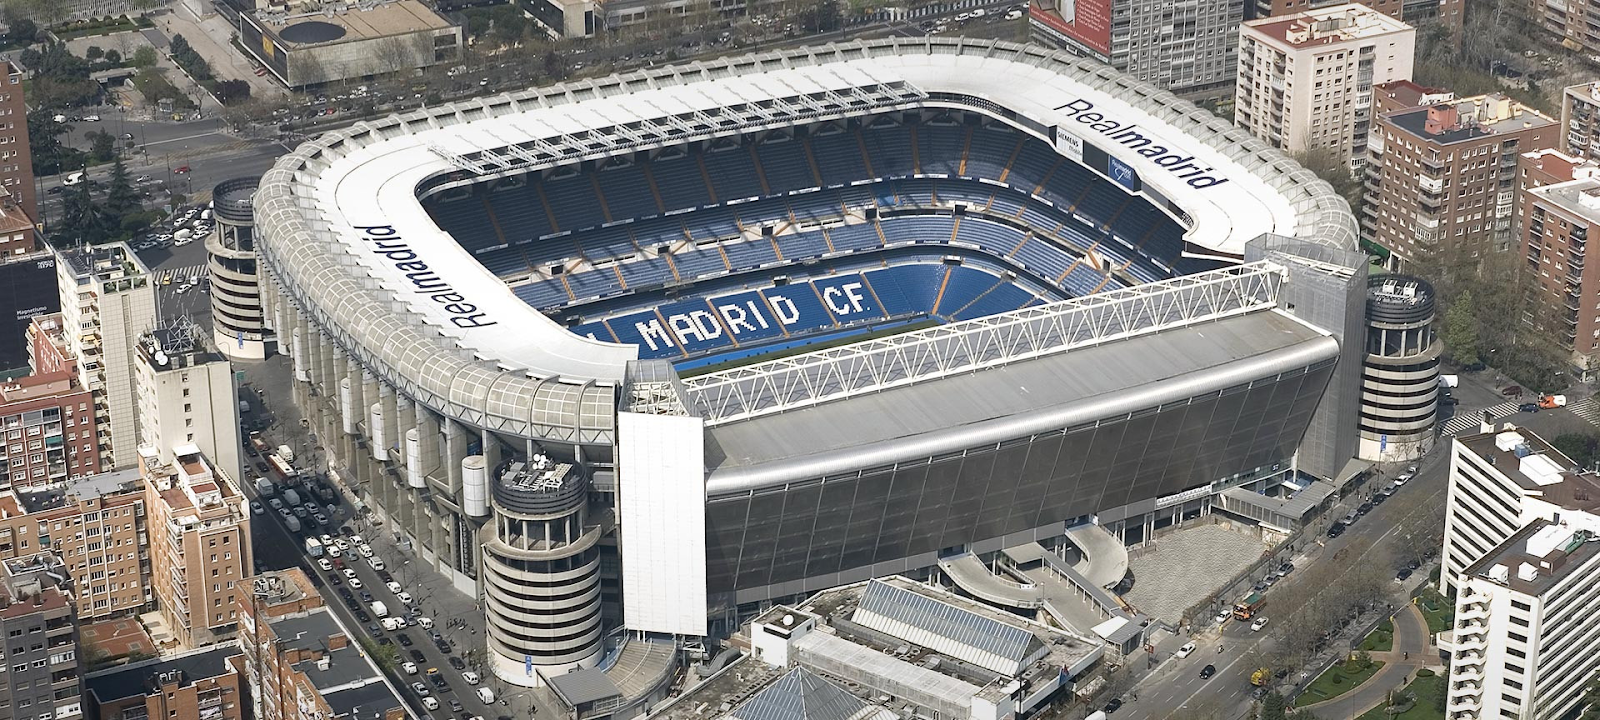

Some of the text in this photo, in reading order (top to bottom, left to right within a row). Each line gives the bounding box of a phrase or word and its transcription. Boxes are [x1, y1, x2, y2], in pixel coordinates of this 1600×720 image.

[1053, 98, 1229, 190] Realmadrid
[1057, 131, 1079, 147] SIEMENS
[353, 225, 498, 328] Realmadrid
